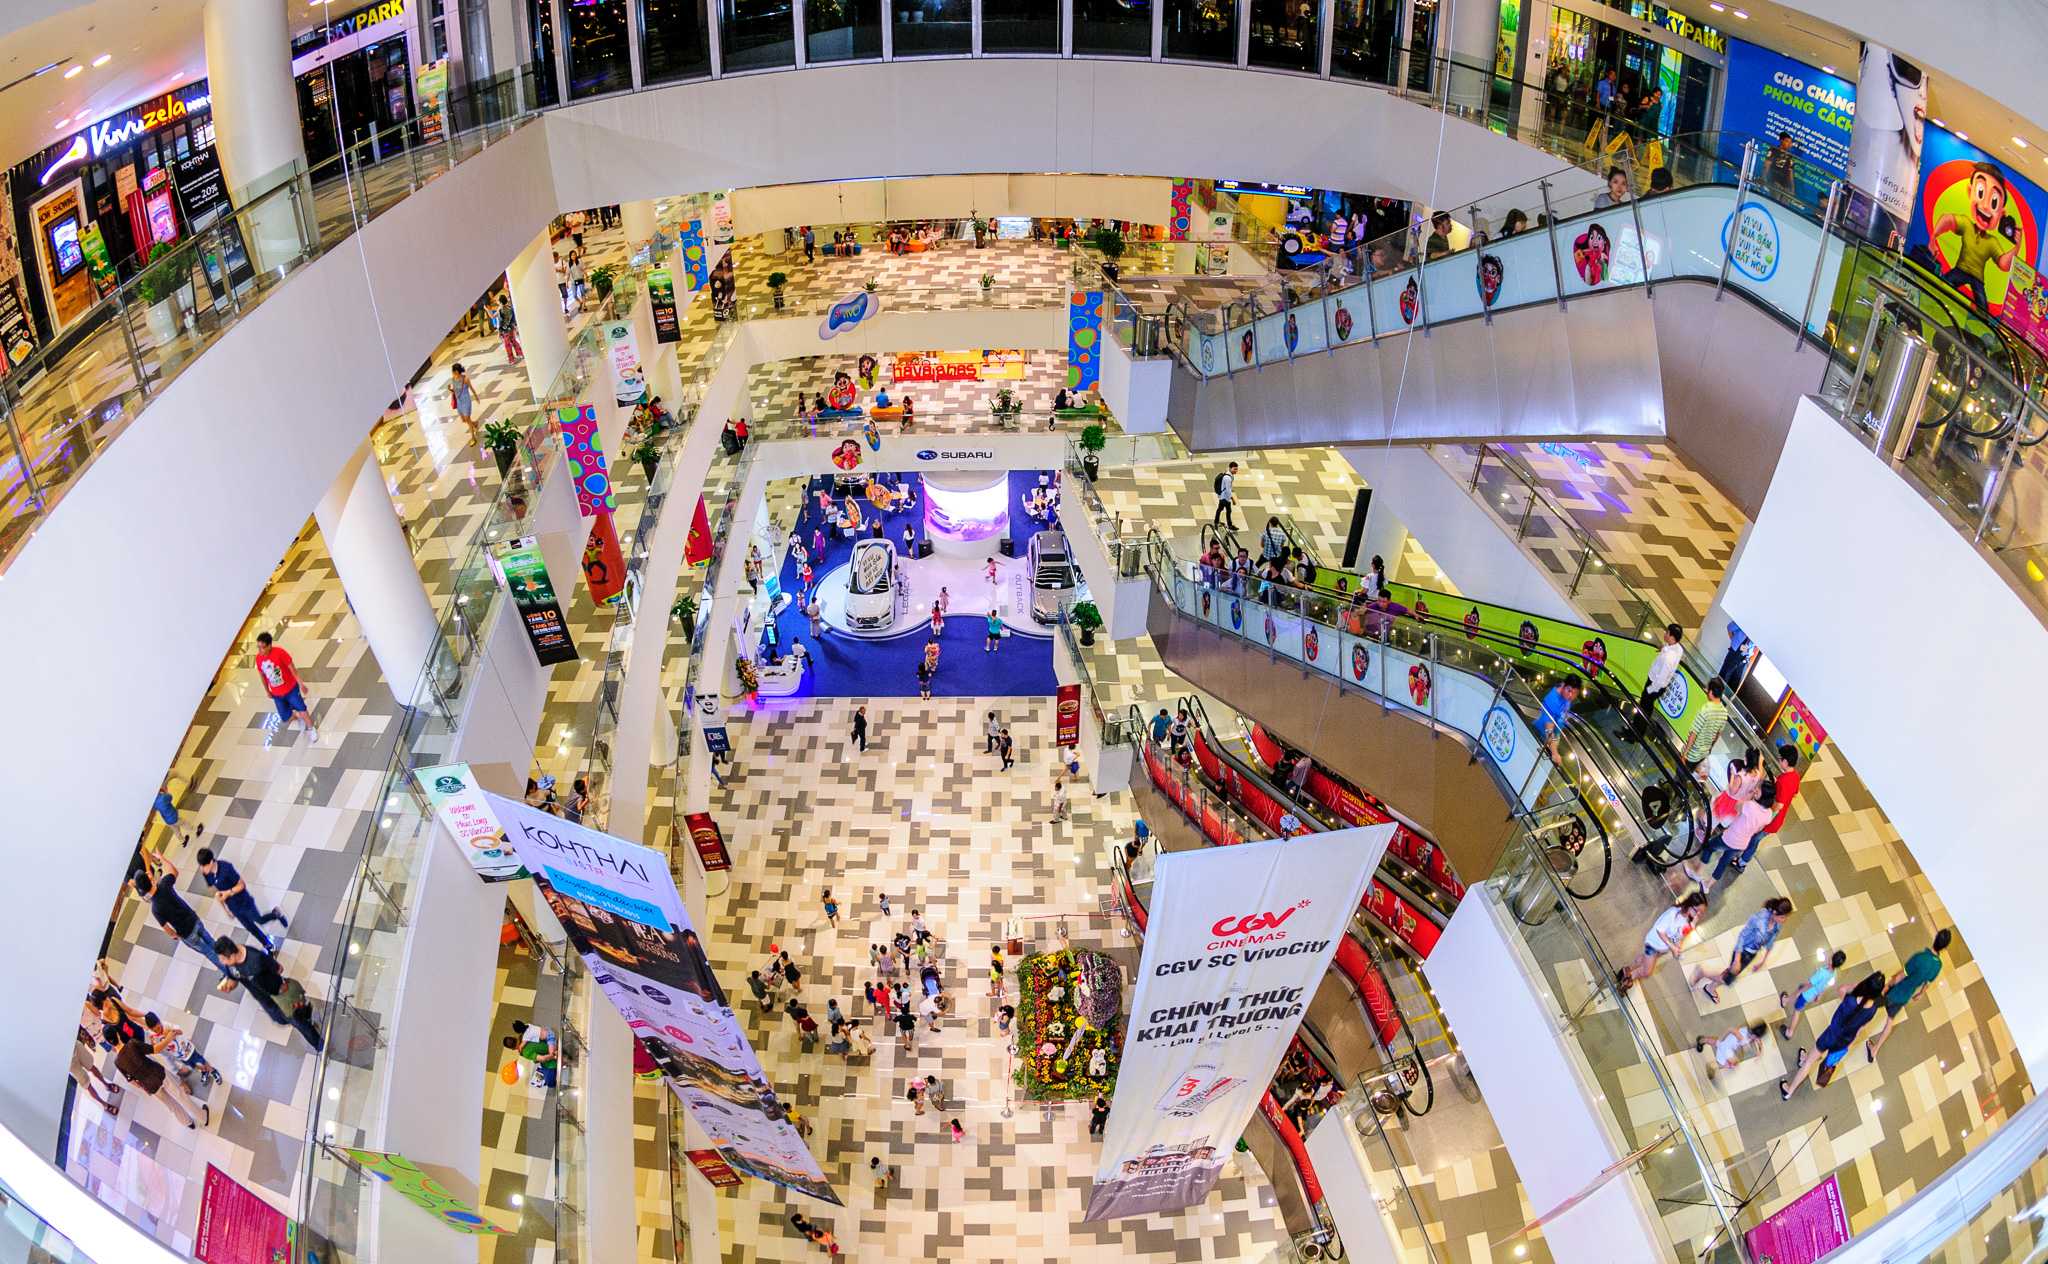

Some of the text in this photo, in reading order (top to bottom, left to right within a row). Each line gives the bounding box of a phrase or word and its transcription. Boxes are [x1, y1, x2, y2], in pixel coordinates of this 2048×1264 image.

[326, 0, 405, 44] SKYPARK
[1763, 85, 1814, 113] PHONG
[1774, 72, 1856, 115] CHO CHÀNG
[90, 95, 186, 156] Vuvuzela
[201, 182, 218, 199] 20%
[941, 451, 993, 459] SUBARU
[1015, 574, 1025, 614] OUTBACK
[519, 821, 650, 883] KOHTHAI
[1211, 907, 1296, 937] CGV
[1155, 940, 1330, 976] CGV SC VivoCity
[1207, 931, 1287, 951] CINEMAS
[1136, 1002, 1304, 1043] KHAI TRƯƠNG
[1150, 985, 1304, 1024] CHÍNH THỨC
[1216, 1028, 1251, 1039] Level
[1255, 1024, 1262, 1032] 5
